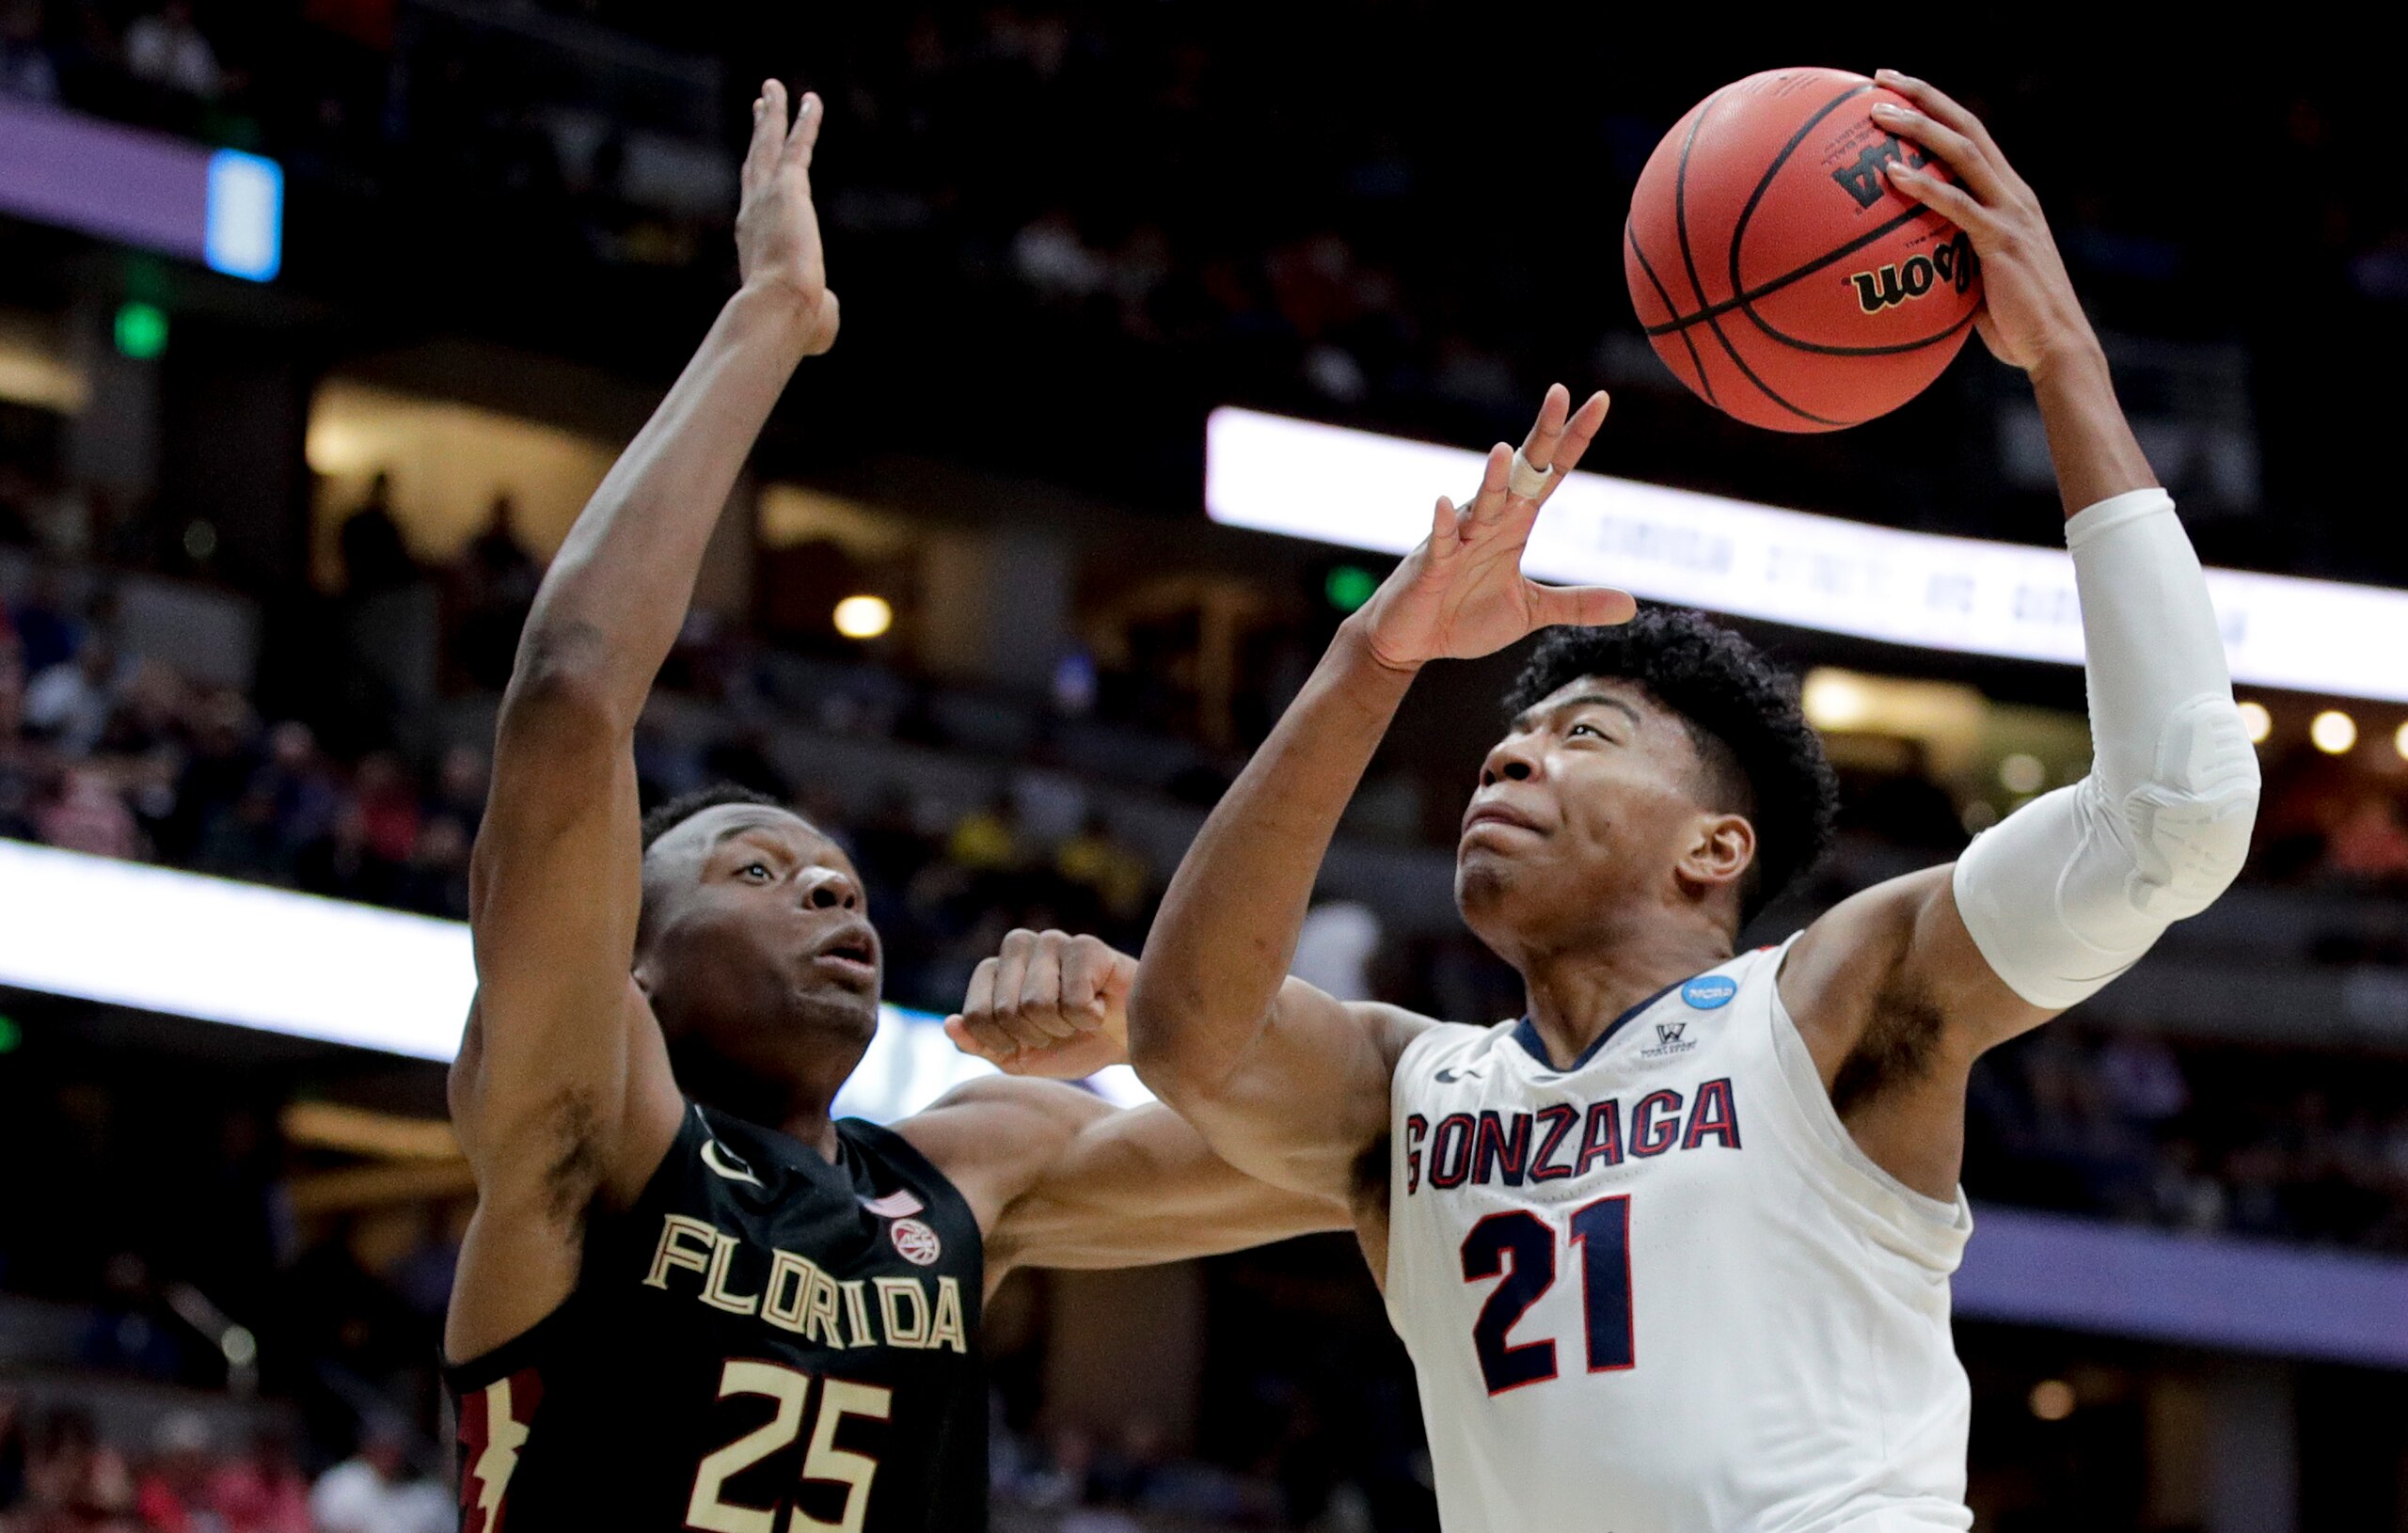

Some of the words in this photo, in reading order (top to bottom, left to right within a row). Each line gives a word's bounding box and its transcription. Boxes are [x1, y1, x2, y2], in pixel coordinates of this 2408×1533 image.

[1406, 1077, 1742, 1195] GONZAGA
[642, 1213, 968, 1354] FLORIDA
[1460, 1193, 1637, 1399] 21
[684, 1358, 895, 1533] 25
